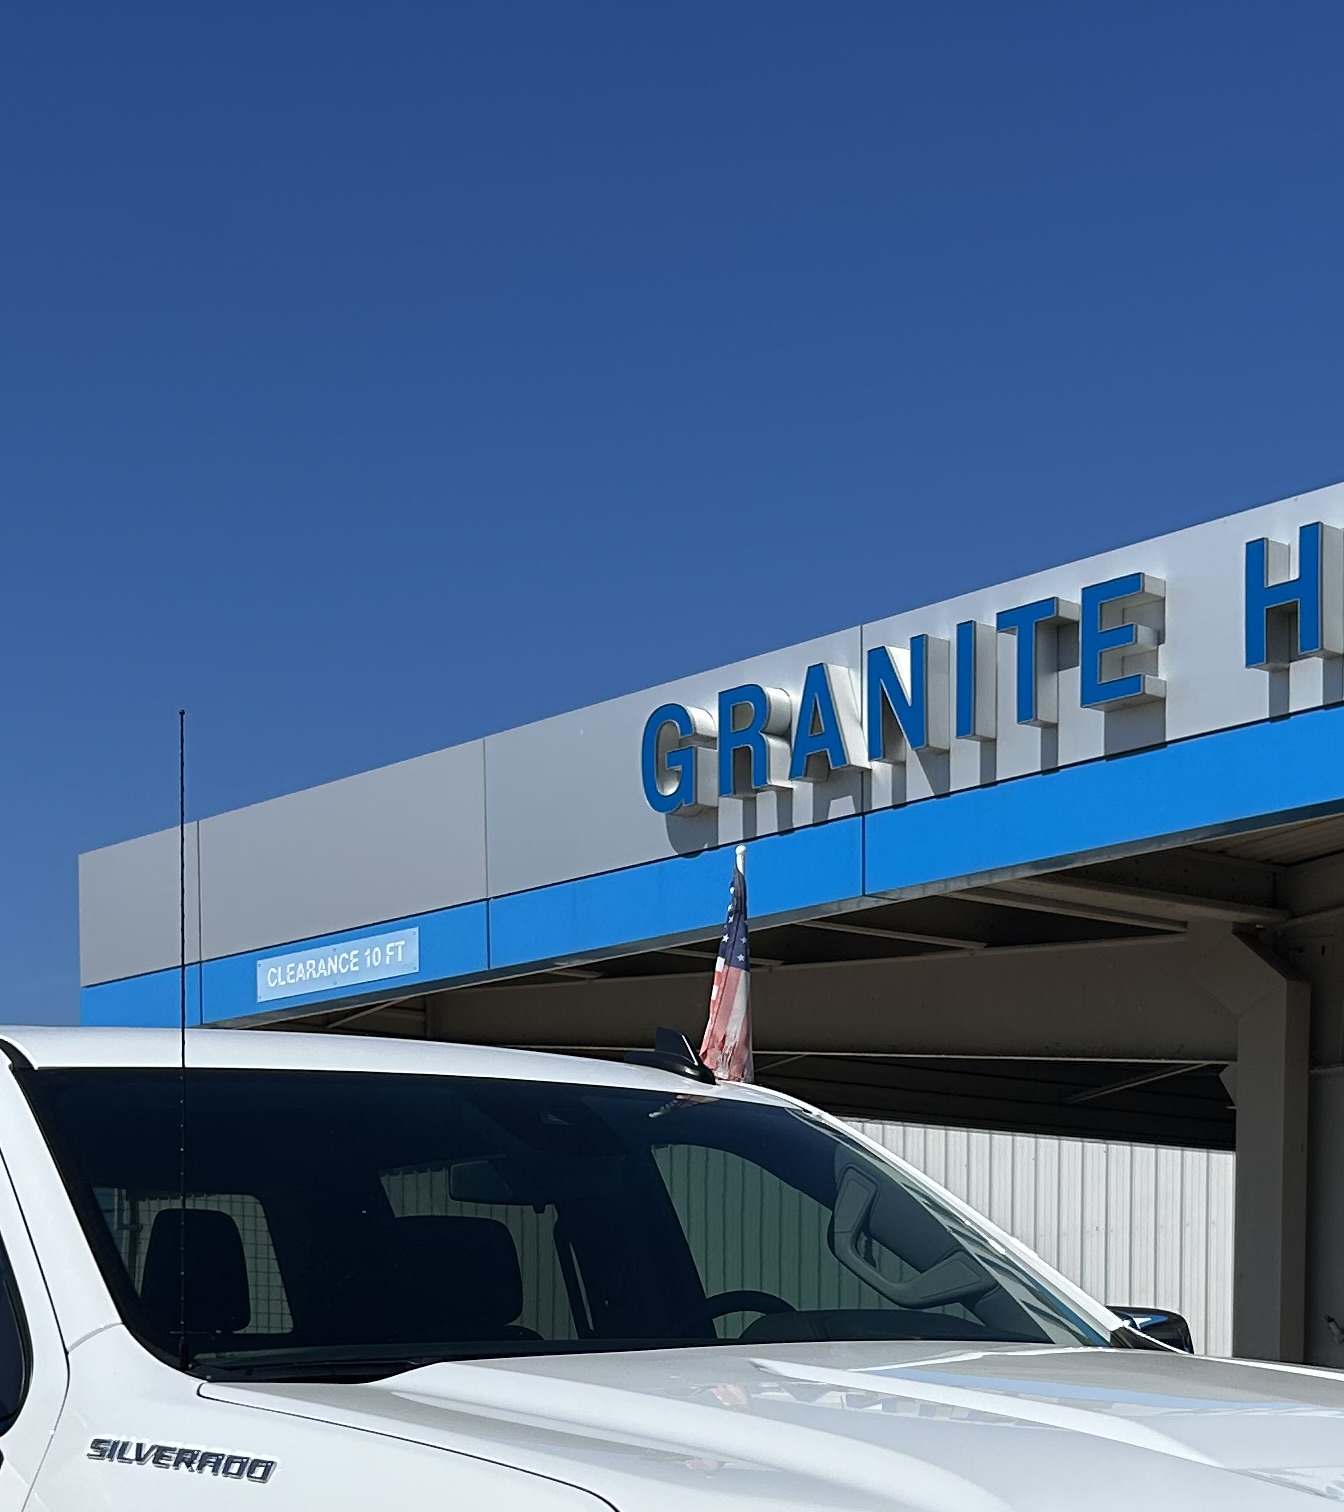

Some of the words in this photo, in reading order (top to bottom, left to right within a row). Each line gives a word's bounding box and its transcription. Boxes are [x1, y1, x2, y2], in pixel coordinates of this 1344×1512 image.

[639, 571, 1164, 815] GRANITE
[267, 950, 359, 988] CLEARANCE
[364, 946, 382, 969] 10
[386, 940, 406, 965] FT
[87, 1438, 278, 1485] SILVERADO
